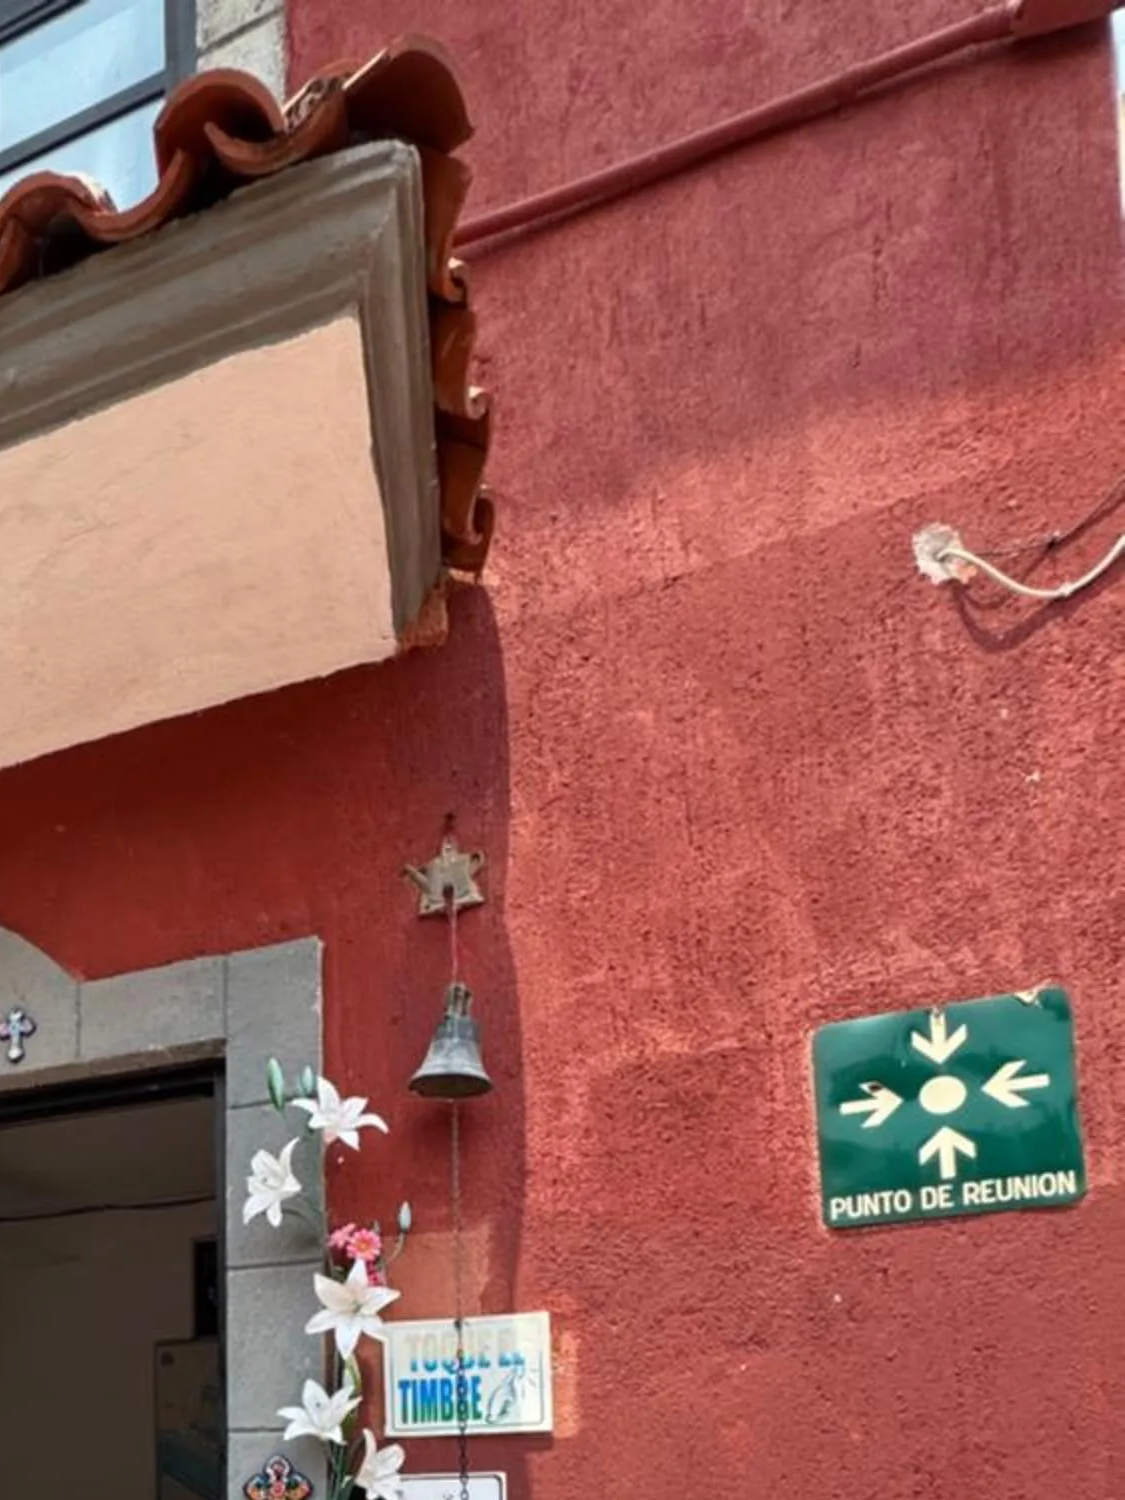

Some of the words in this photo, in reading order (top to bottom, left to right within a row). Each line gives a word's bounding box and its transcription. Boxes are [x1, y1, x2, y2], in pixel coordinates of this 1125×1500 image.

[830, 1189, 912, 1221] PUNTO
[920, 1184, 955, 1210] DE
[962, 1169, 1077, 1206] REUNION
